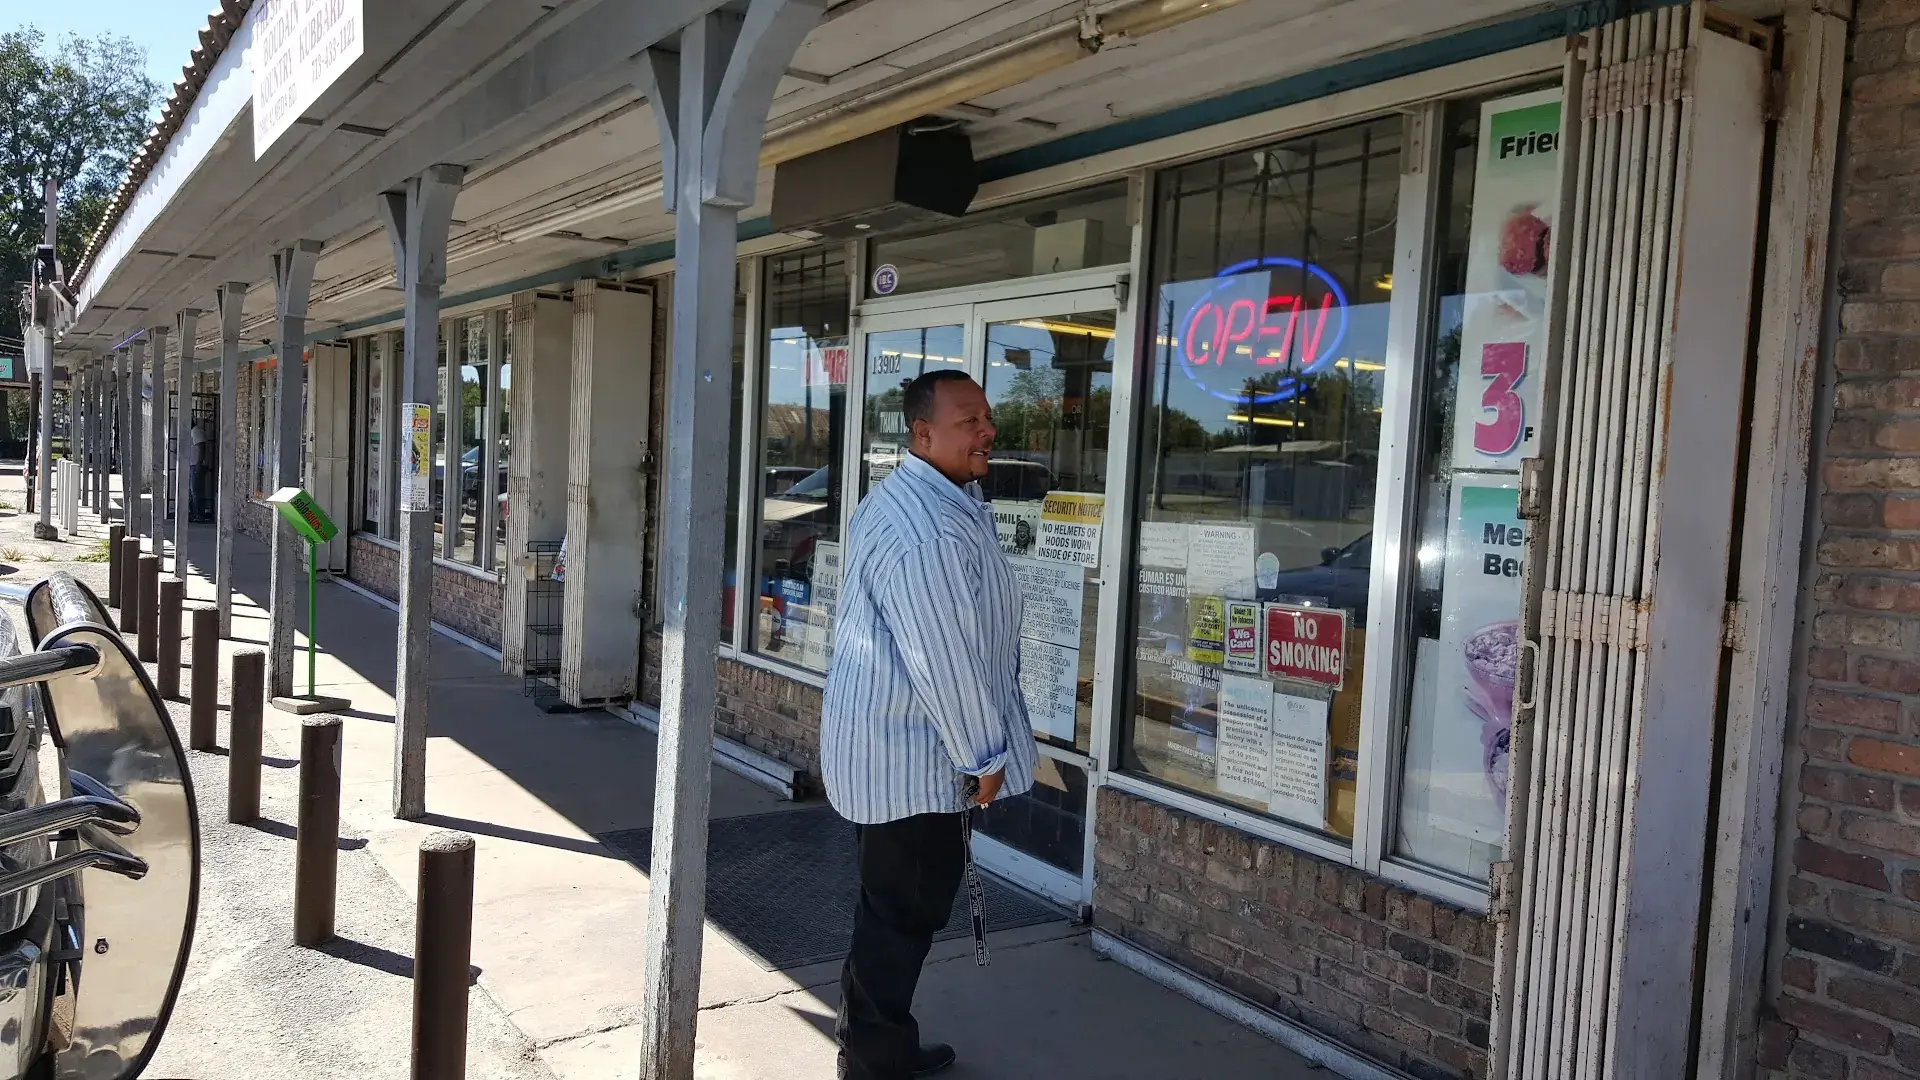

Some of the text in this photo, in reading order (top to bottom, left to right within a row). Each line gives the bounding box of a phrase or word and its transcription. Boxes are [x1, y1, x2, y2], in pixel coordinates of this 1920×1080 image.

[1185, 292, 1333, 367] OPEN
[873, 354, 900, 375] 13902
[1473, 340, 1529, 458] 3
[880, 412, 899, 433] THANK
[1043, 500, 1102, 518] SECURITY NOTICE
[994, 513, 1021, 525] SMILE
[1042, 523, 1096, 538] NO HELMETS OR
[1204, 529, 1237, 540] WARNING
[1045, 536, 1091, 551] HOODS WORN
[1038, 547, 1061, 559] INSIDE
[1062, 551, 1071, 561] OF
[1139, 568, 1163, 585] FUMAR
[1165, 572, 1174, 585] ES
[1175, 573, 1185, 586] UN
[1032, 584, 1038, 592] AN
[1038, 585, 1056, 595] OPENLY
[1061, 579, 1080, 590] LICENSE
[1138, 580, 1185, 600] COSTOSO HABITO
[1049, 595, 1067, 606] PERSON
[1051, 605, 1072, 616] CHAPTER
[1234, 607, 1246, 615] Under
[1055, 615, 1078, 627] LICENSING
[1238, 617, 1254, 625] Tobacco
[1035, 620, 1059, 632] PROPERTY
[1059, 625, 1071, 635] WITH
[1233, 628, 1250, 639] We
[1293, 616, 1318, 640] NO
[1230, 638, 1254, 649] Card
[1054, 647, 1063, 657] DEL
[1269, 640, 1340, 675] SMOKING
[1027, 667, 1058, 683] PERSONA CON
[1054, 665, 1064, 675] UNA
[1171, 659, 1221, 680] SMOKING IS AN
[1171, 671, 1221, 691] EXPENSIVE HABIT
[1050, 700, 1072, 715] NO PUEDE
[1223, 699, 1267, 715] The unlicensed
[1222, 708, 1254, 722] possession
[1256, 715, 1262, 723] of
[1225, 725, 1252, 737] premises
[1253, 723, 1268, 733] these
[1225, 732, 1244, 743] felony
[1246, 737, 1257, 746] with
[1277, 739, 1285, 747] sin
[1296, 735, 1322, 747] de armas
[1310, 755, 1317, 763] un
[1244, 768, 1254, 777] not
[1256, 763, 1267, 772] and
[1306, 763, 1316, 772] una
[1310, 772, 1317, 780] de
[1307, 789, 1315, 797] sin
[967, 862, 975, 886] CLASS
[976, 940, 985, 965] CLASS
